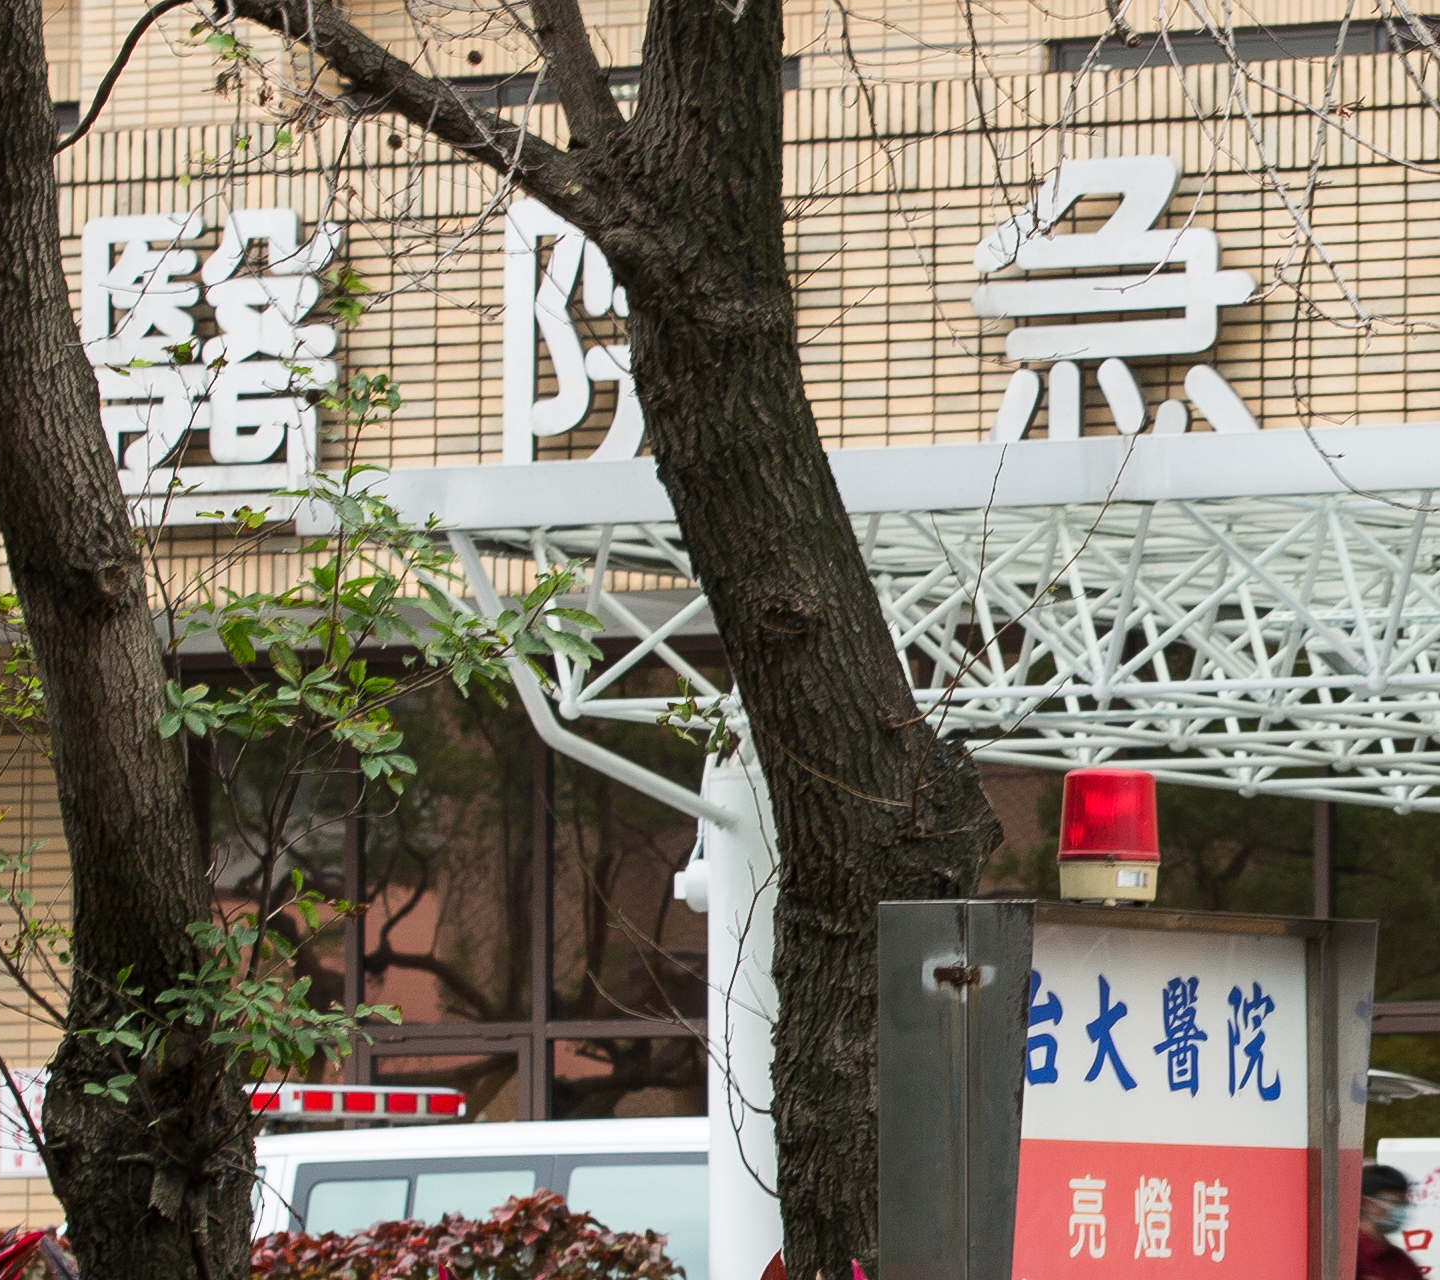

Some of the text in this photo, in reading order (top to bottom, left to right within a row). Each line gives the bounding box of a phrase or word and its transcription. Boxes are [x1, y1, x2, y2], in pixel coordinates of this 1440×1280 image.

[1025, 969, 1281, 1102] 台大醫院
[1068, 1174, 1230, 1261] 亮燈時
